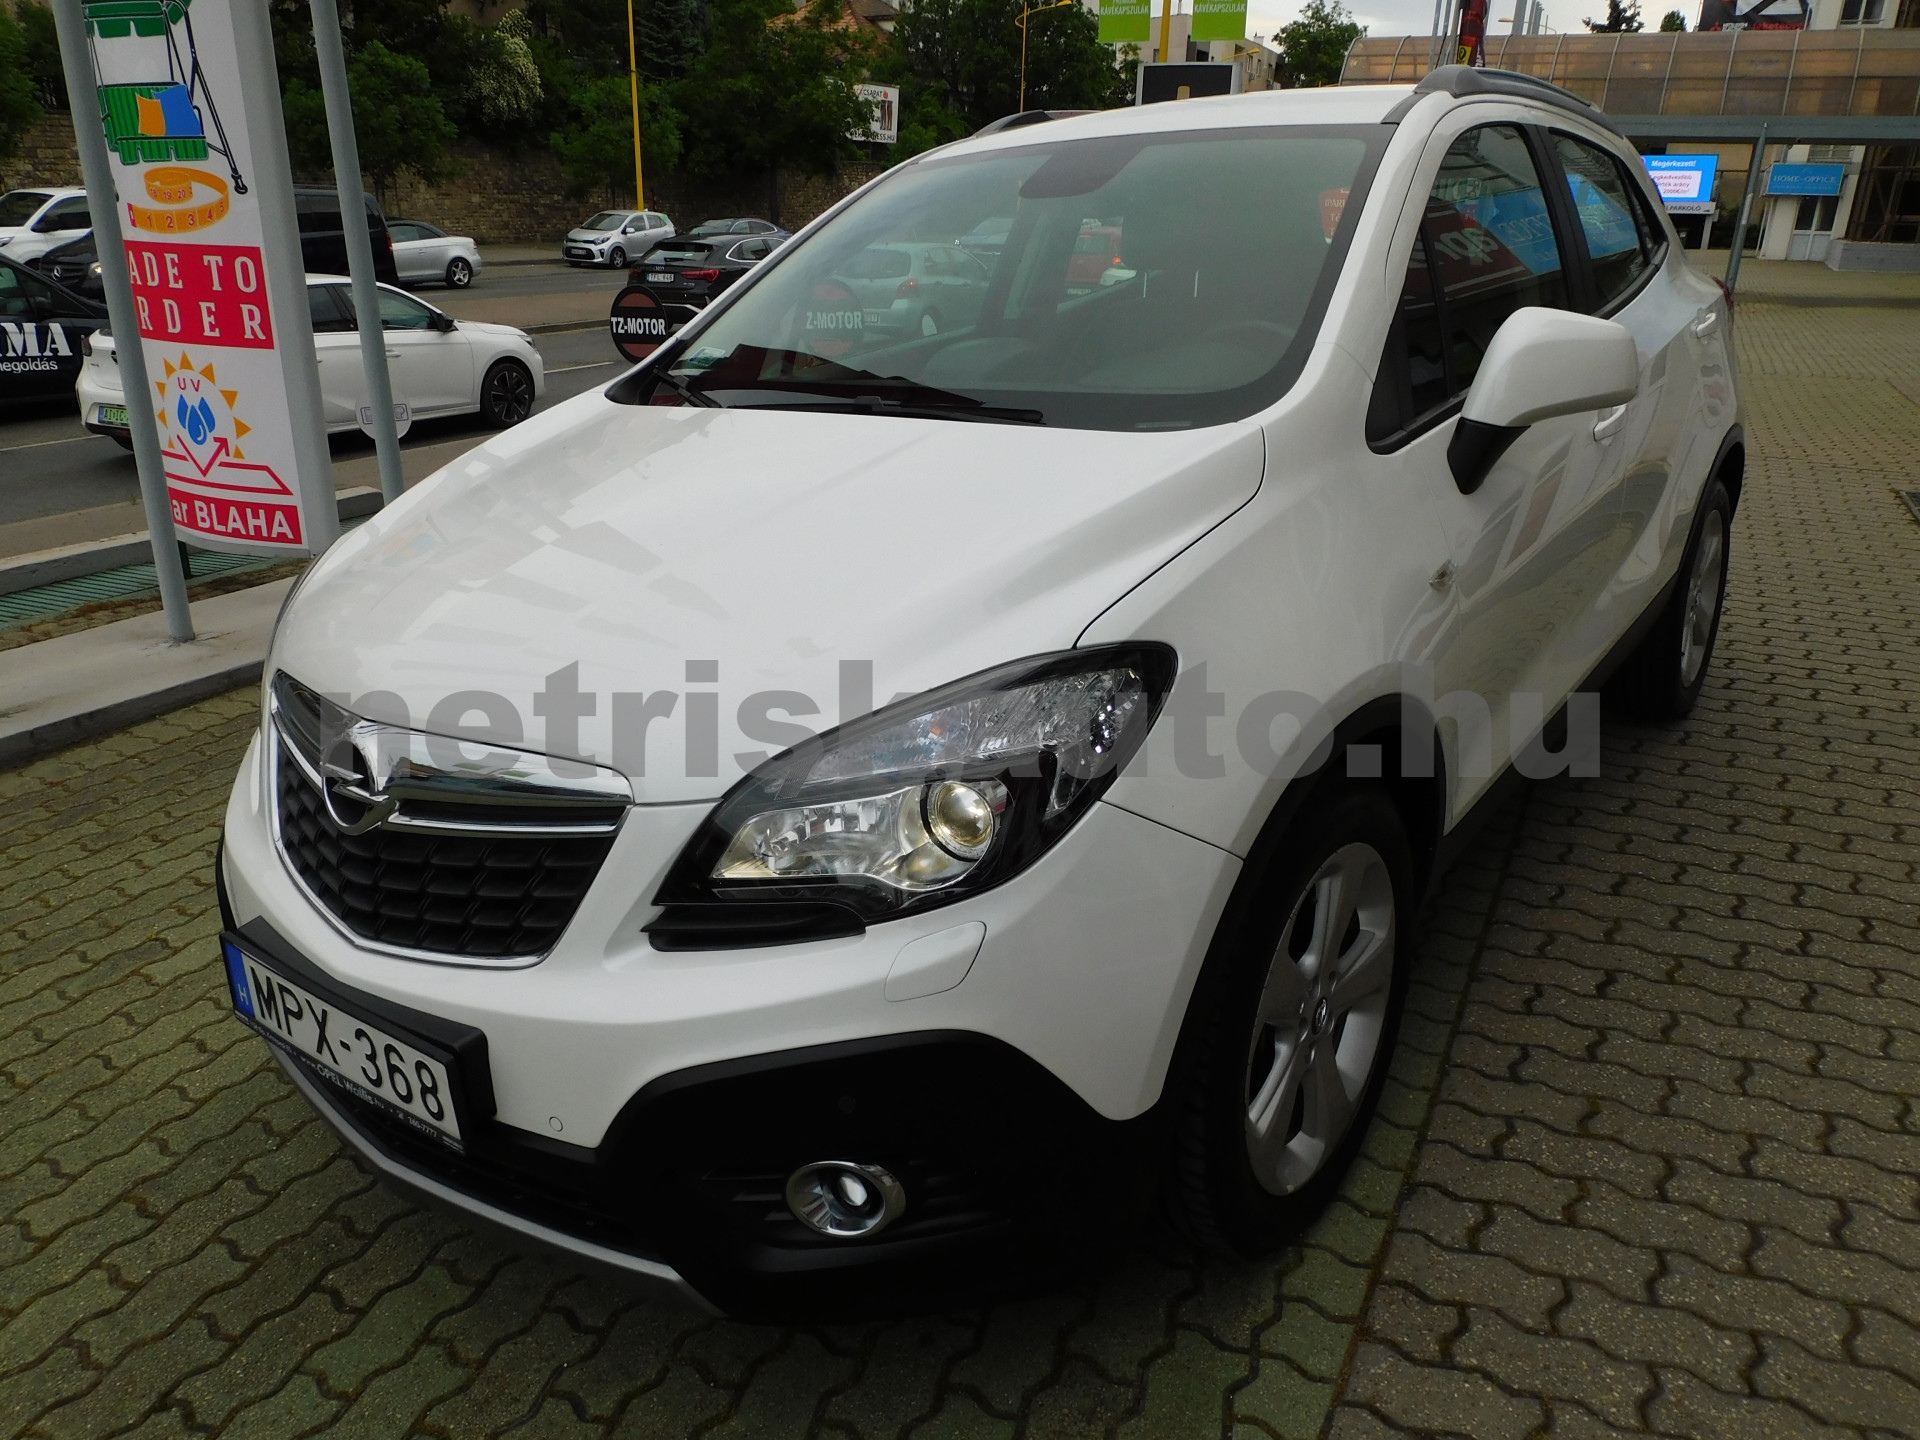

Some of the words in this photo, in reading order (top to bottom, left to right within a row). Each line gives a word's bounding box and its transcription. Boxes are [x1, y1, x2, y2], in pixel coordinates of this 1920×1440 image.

[166, 215, 174, 228] 2
[187, 213, 195, 226] 3
[128, 250, 184, 289] ADE
[203, 255, 258, 293] TO
[136, 295, 267, 340] RDER
[611, 316, 666, 335] TZ-MOTOR
[0, 322, 73, 357] MA
[172, 499, 189, 524] ar
[194, 499, 294, 540] BLAHA
[250, 964, 445, 1122] MPX-368
